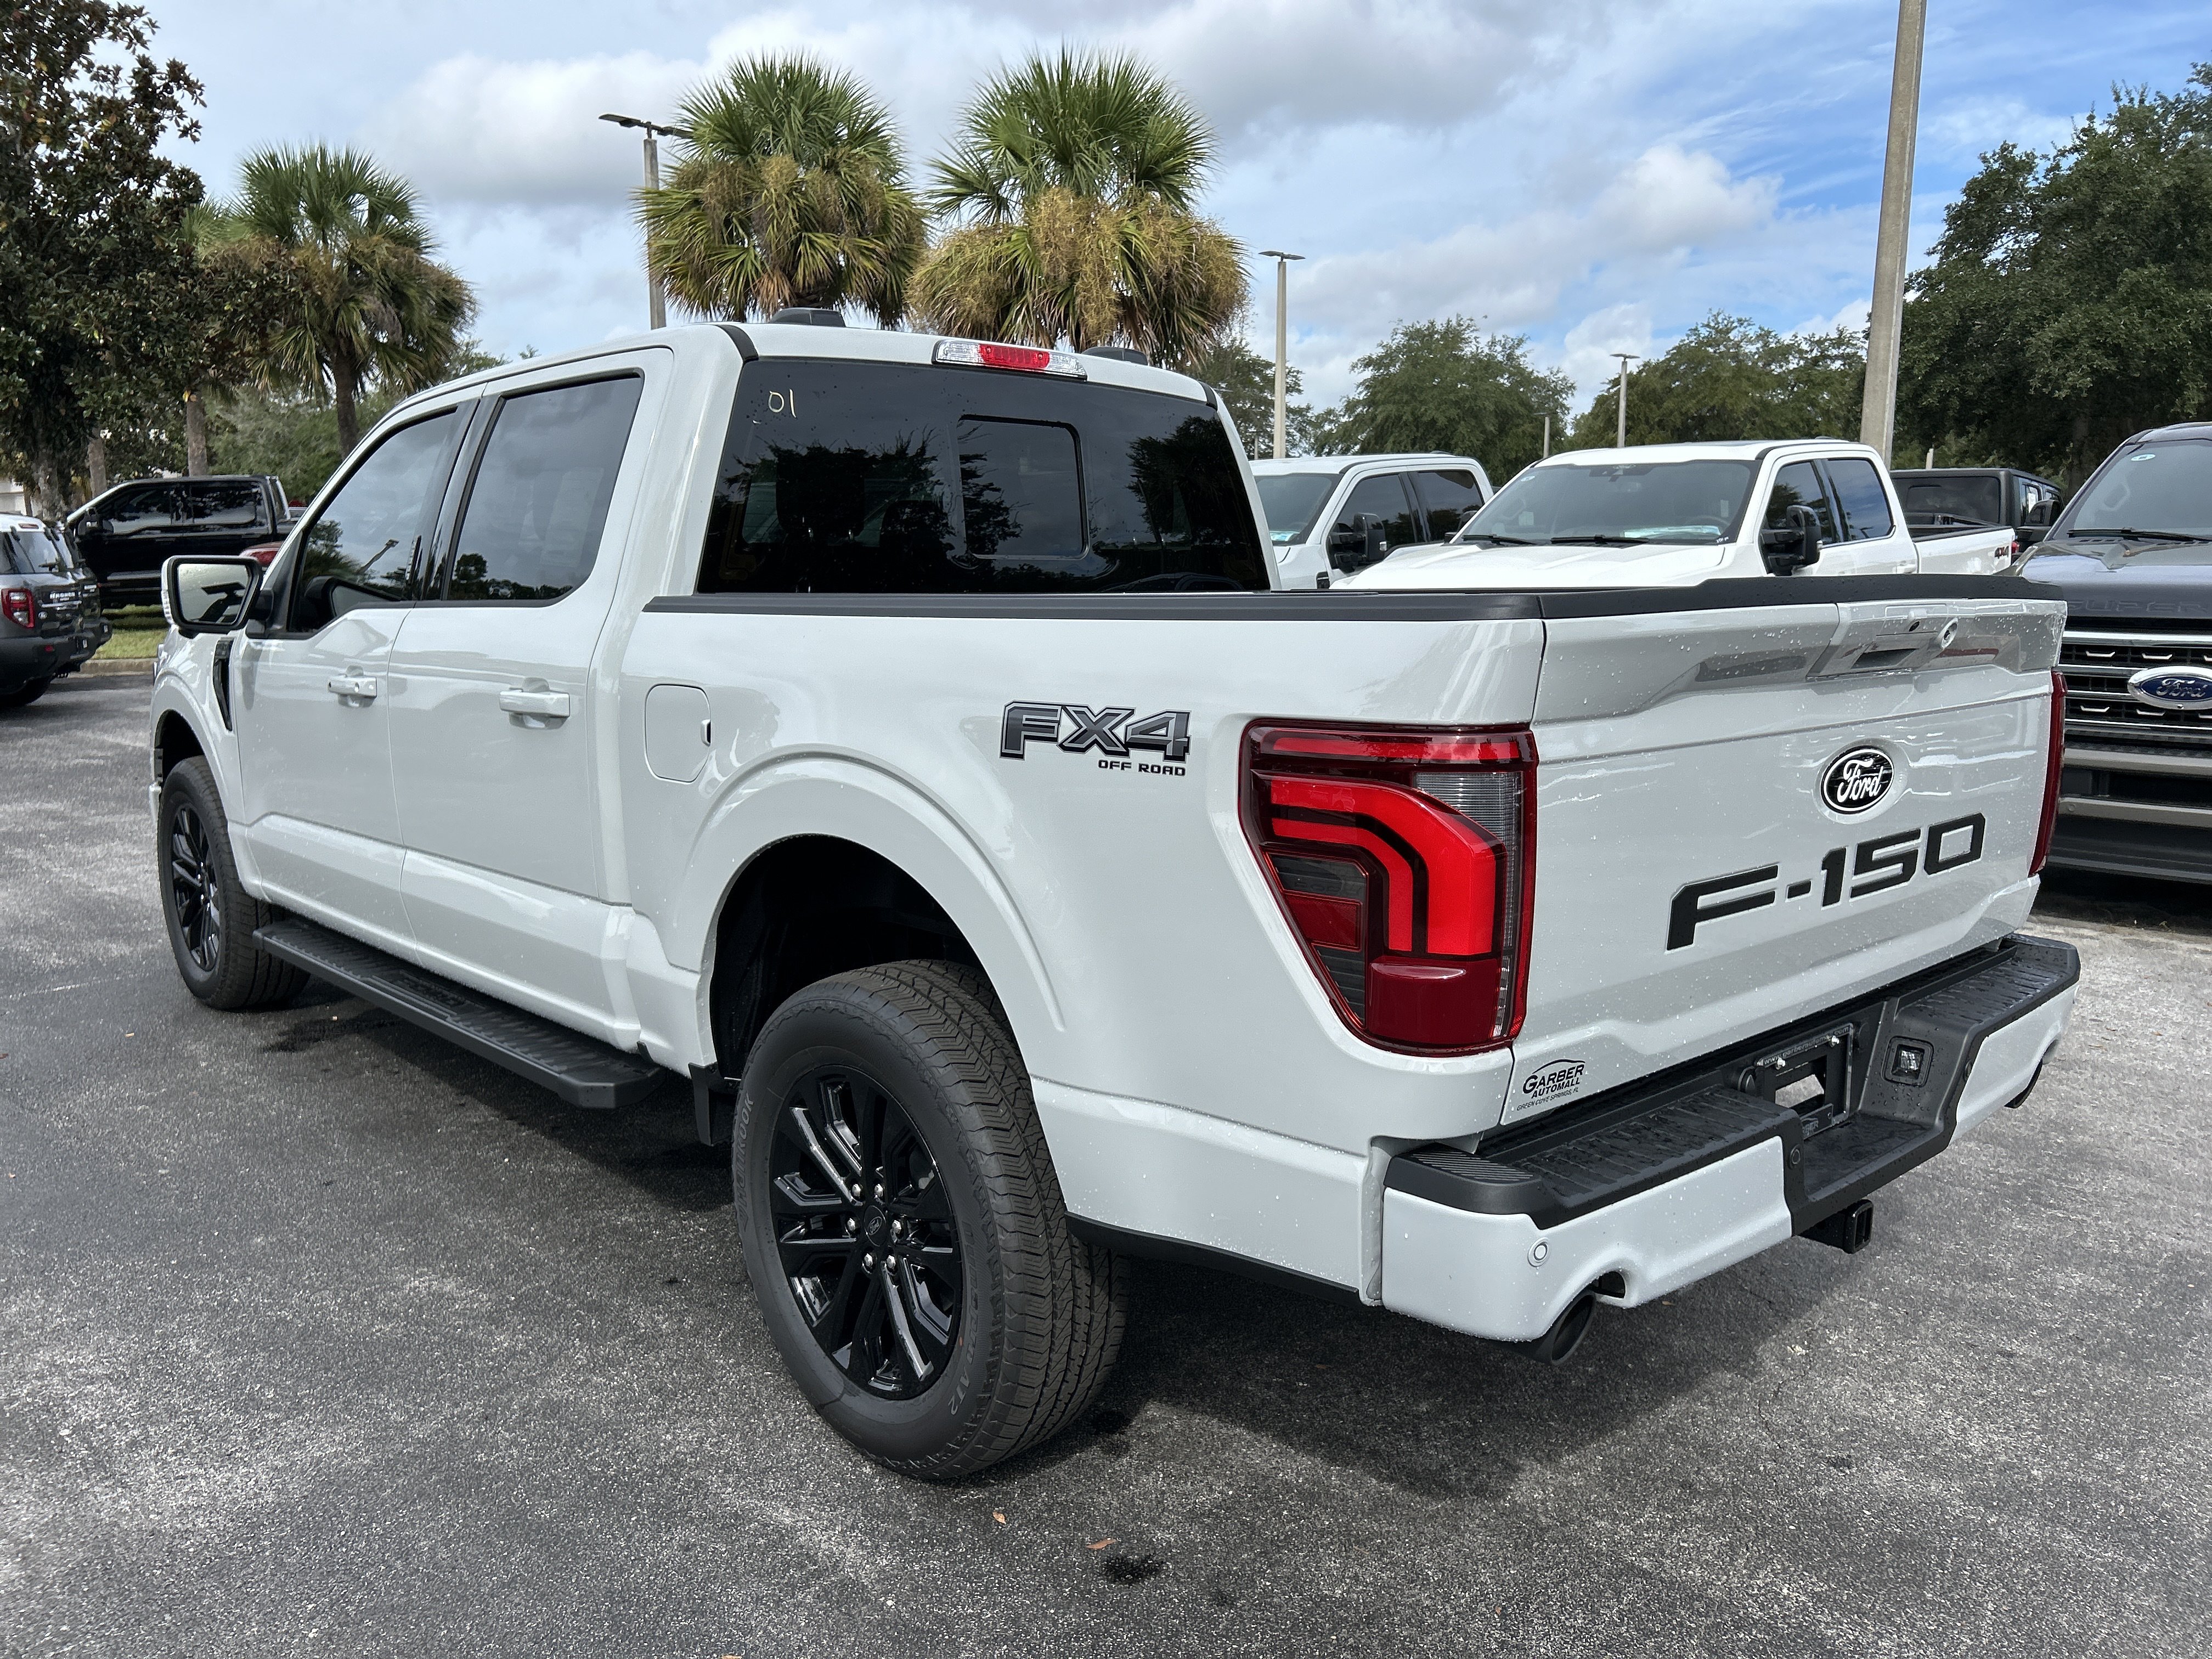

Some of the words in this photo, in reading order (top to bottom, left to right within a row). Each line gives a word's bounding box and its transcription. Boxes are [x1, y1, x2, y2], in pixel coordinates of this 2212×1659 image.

[2156, 678, 2208, 698] Ford
[999, 699, 1192, 763] FX4
[1098, 759, 1132, 771] OFF
[1138, 763, 1186, 777] ROAD
[1836, 759, 1883, 803] Ford
[1666, 812, 1986, 951] F-150
[1522, 1064, 1585, 1094] GARBER
[1531, 1077, 1581, 1099] AUTOMALL
[1516, 1100, 1536, 1111] GREEN
[1535, 1096, 1550, 1105] COVE
[947, 1366, 970, 1416] AT2
